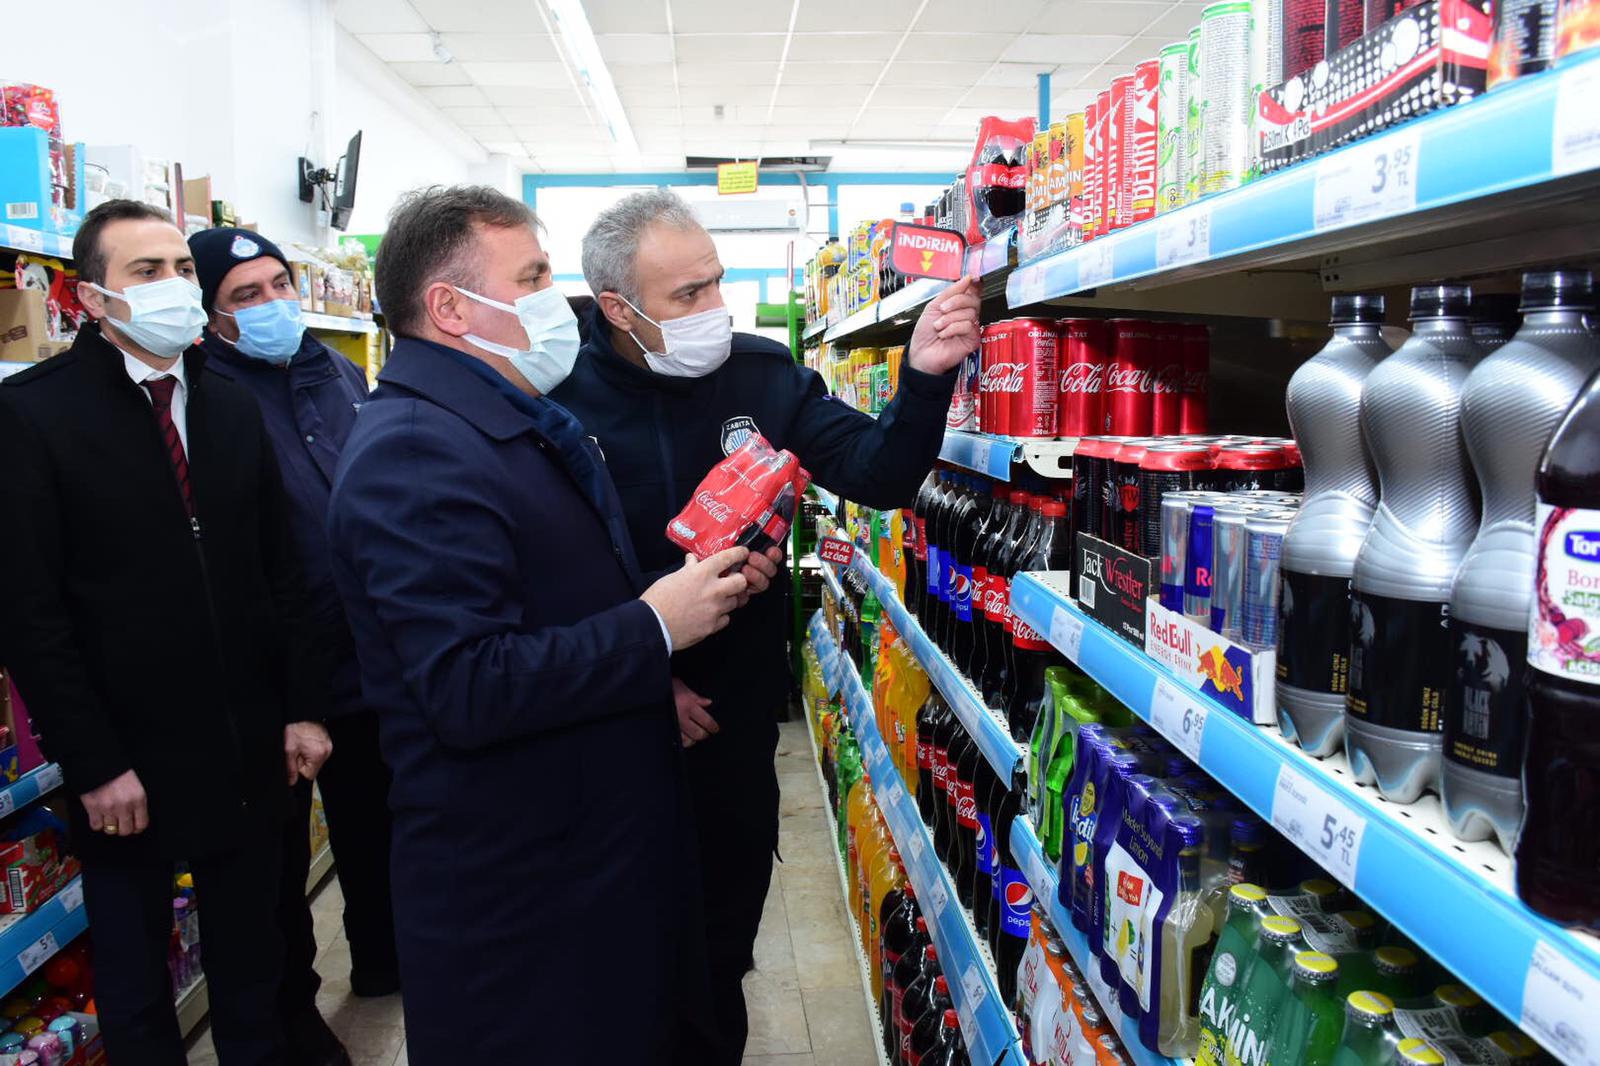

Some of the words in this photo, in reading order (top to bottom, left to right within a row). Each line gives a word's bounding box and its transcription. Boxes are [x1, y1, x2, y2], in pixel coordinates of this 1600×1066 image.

[726, 420, 750, 431] ZABITA
[1082, 547, 1105, 579] Jack
[1104, 557, 1144, 602] Wrestler
